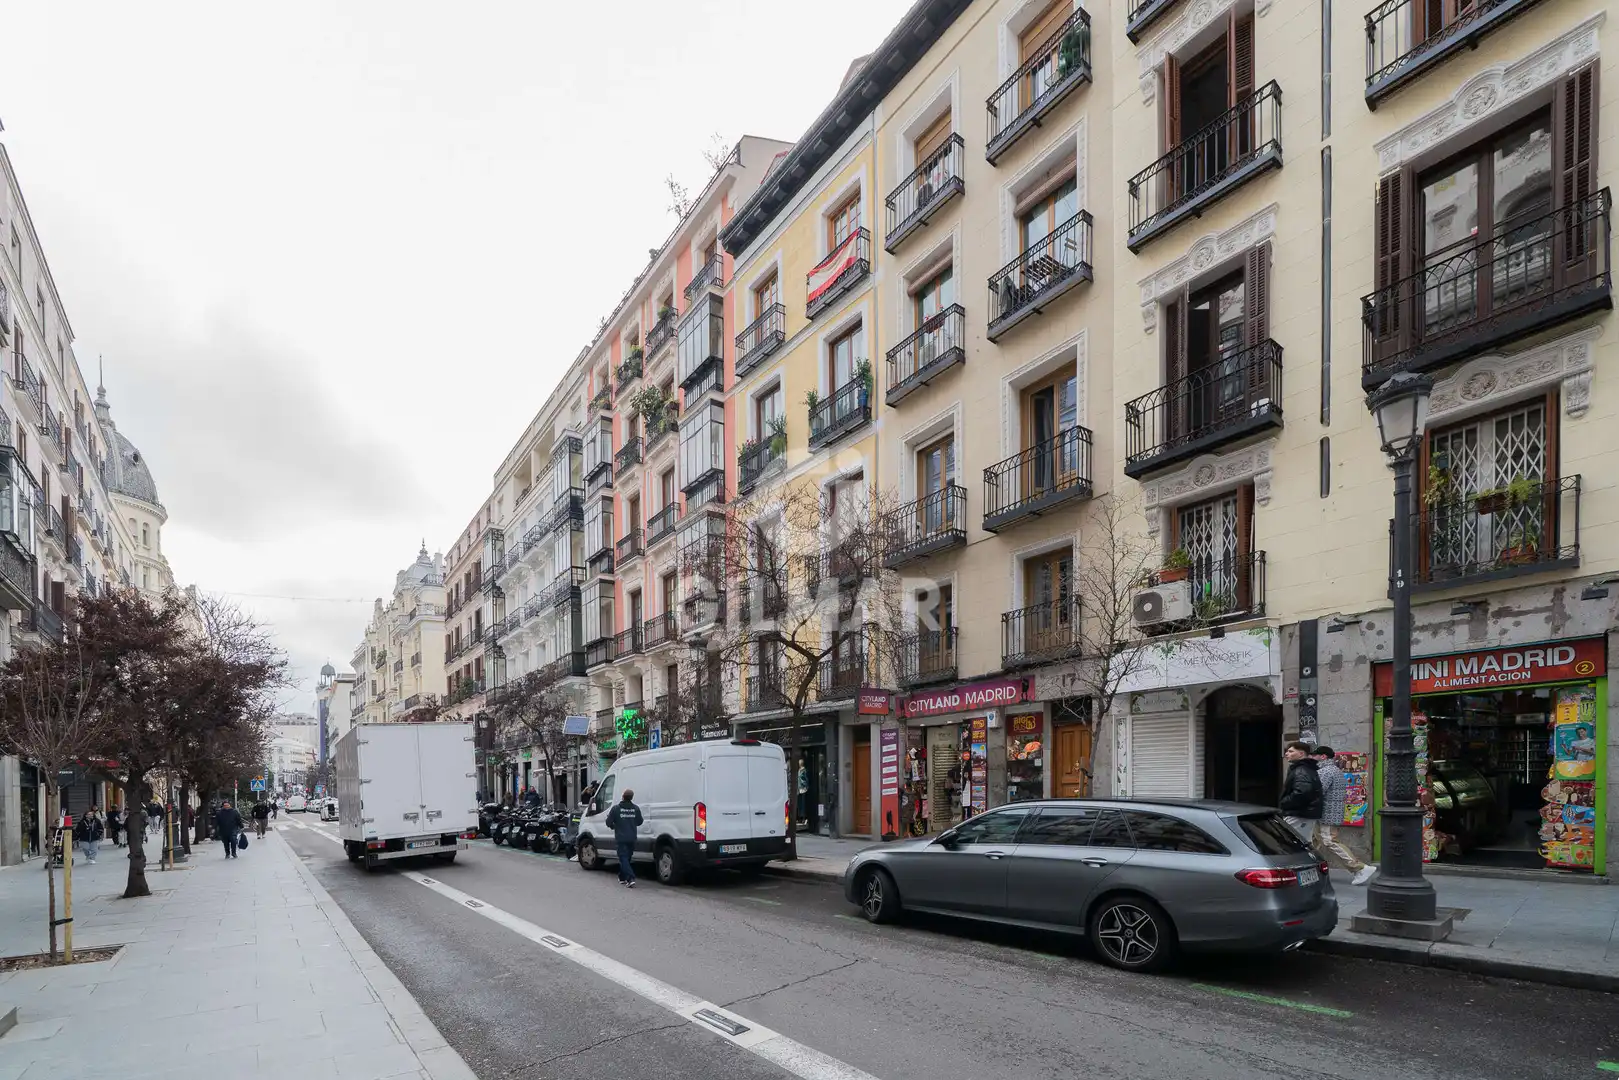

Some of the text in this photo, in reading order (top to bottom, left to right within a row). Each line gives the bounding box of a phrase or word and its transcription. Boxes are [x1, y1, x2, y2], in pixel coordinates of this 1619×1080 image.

[1455, 646, 1576, 676] MADRID
[1062, 672, 1077, 688] 17
[1433, 670, 1531, 688] ALIMENTACION
[861, 695, 887, 703] CITYLAND
[908, 686, 1017, 713] CITYLAND MADRID
[651, 731, 658, 749] P
